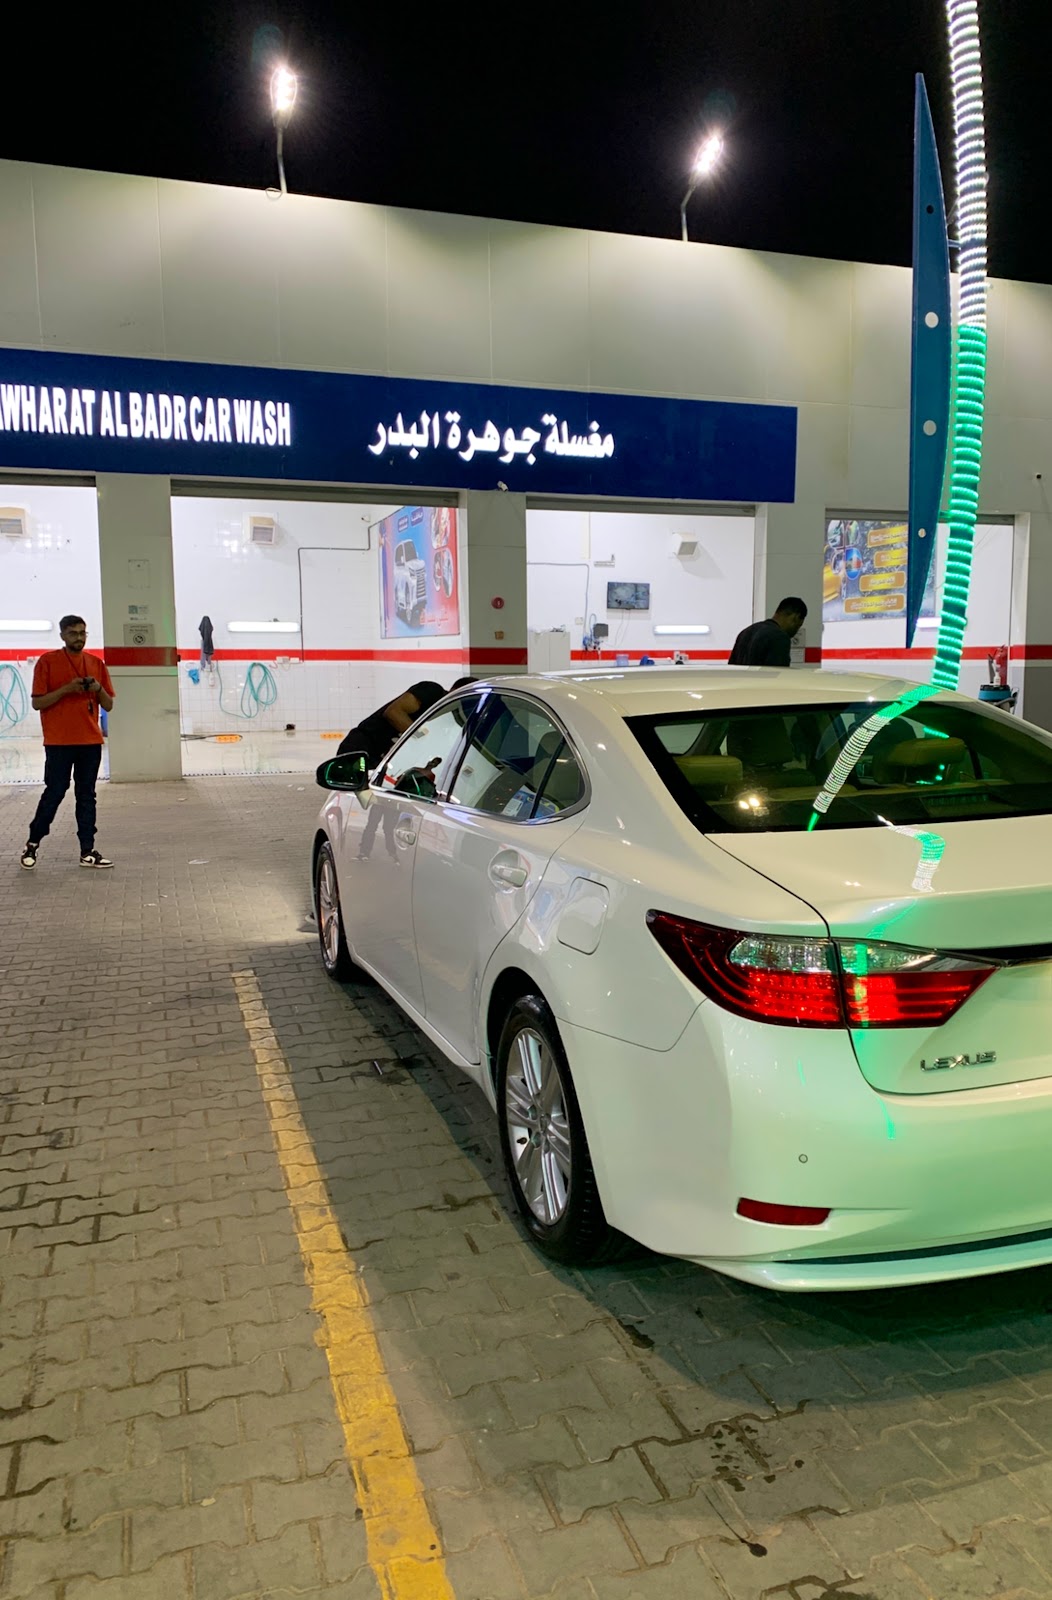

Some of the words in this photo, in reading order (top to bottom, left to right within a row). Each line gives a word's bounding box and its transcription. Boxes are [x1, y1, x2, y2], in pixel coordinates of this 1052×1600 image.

[0, 384, 95, 435] WHARAT
[101, 391, 128, 437] AL
[129, 392, 187, 440] BADR
[190, 396, 232, 442] CAR
[234, 399, 290, 446] WASH
[368, 411, 439, 459] البدر
[444, 410, 541, 466] جوهرة
[542, 414, 614, 458] مغسلة
[920, 1051, 997, 1072] LEXUS
